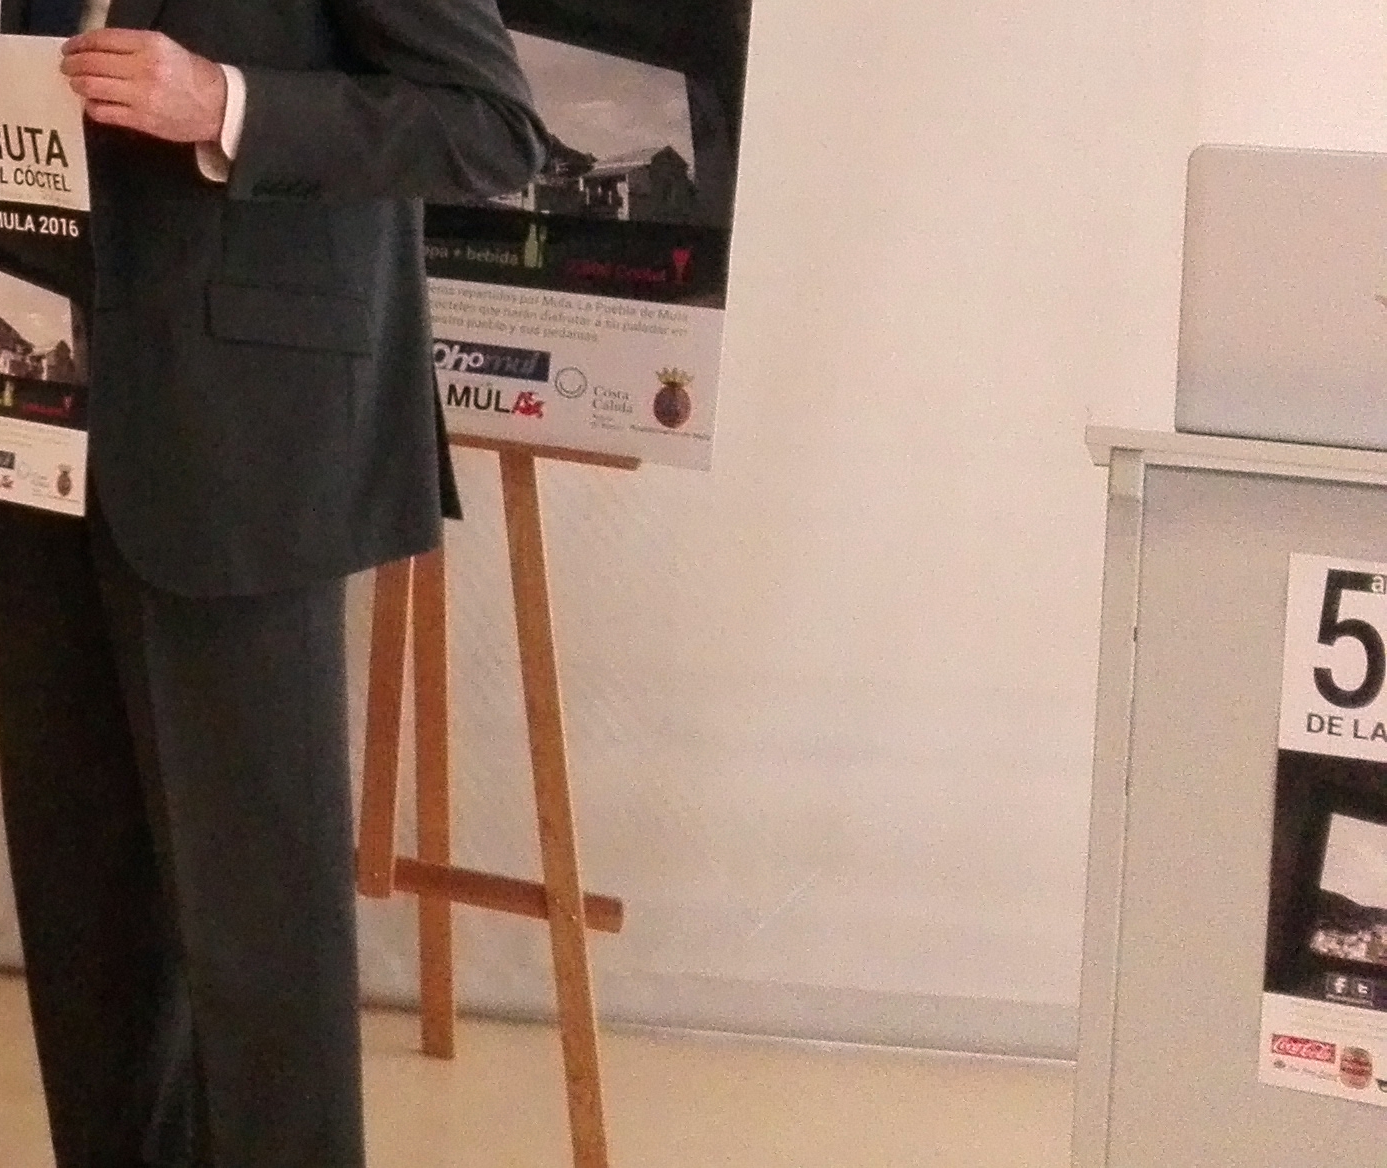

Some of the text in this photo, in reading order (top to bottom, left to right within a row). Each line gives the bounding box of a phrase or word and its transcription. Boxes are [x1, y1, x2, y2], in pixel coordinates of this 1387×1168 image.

[13, 164, 72, 193] CÓCTEL
[38, 216, 79, 238] 2016
[1306, 713, 1387, 743] DE LA
